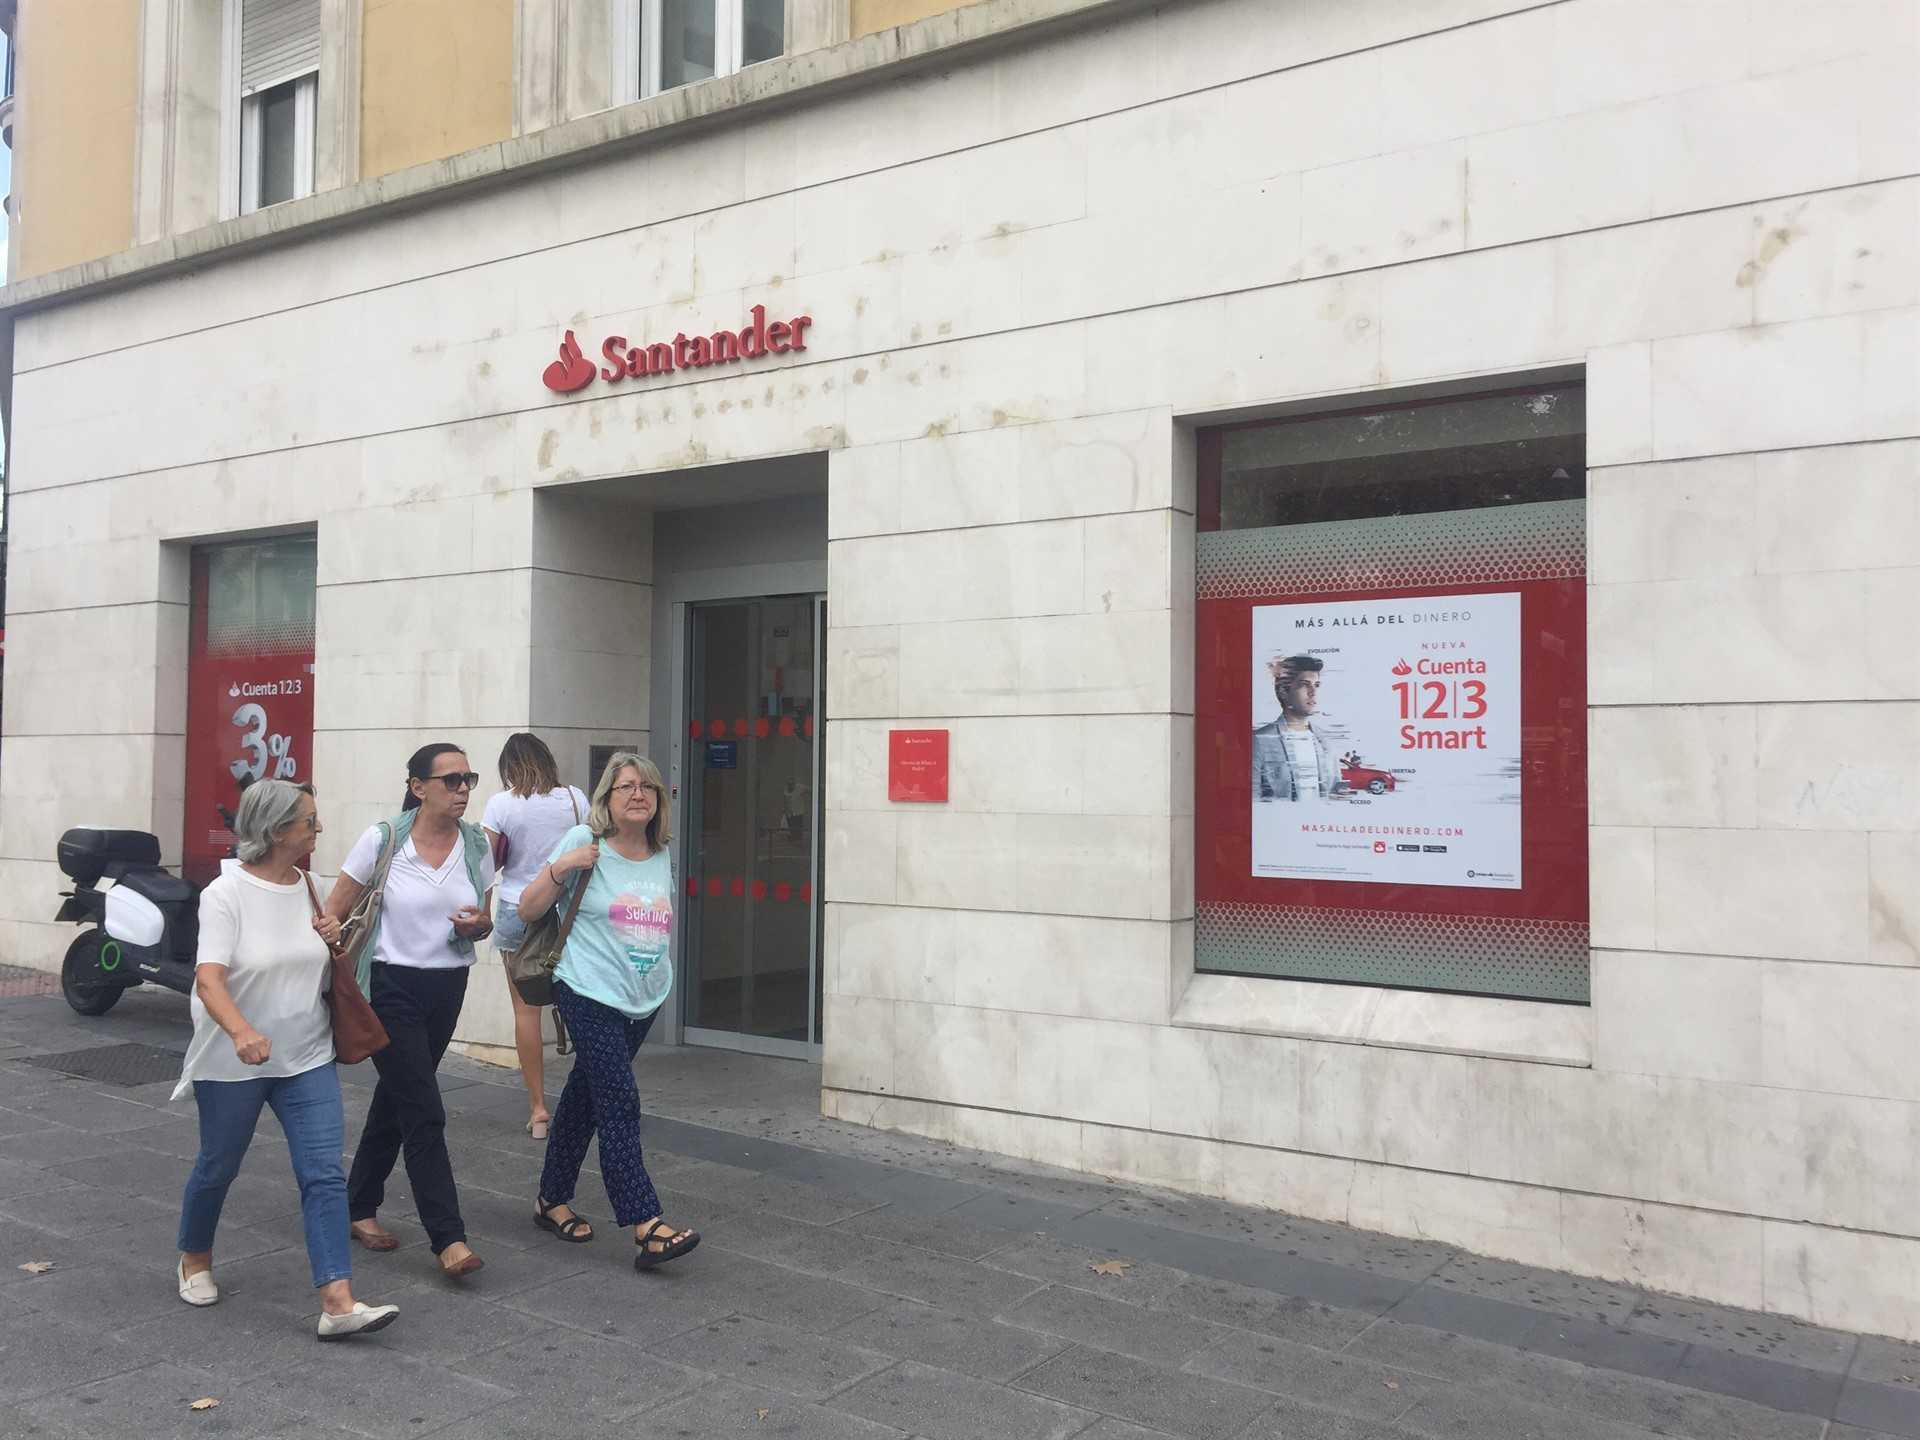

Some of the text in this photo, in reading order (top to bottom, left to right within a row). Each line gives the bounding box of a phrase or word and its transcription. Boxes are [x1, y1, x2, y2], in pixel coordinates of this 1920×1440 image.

[601, 303, 812, 384] Santander
[1294, 610, 1472, 629] MÁS ALLÁ DEL DINERO
[1421, 641, 1466, 650] NUEVA
[1416, 658, 1486, 675] Cuenta
[241, 681, 278, 697] Cuenta
[1400, 723, 1487, 749] Smart
[1301, 825, 1464, 836] MASALLADELDINERO.COM
